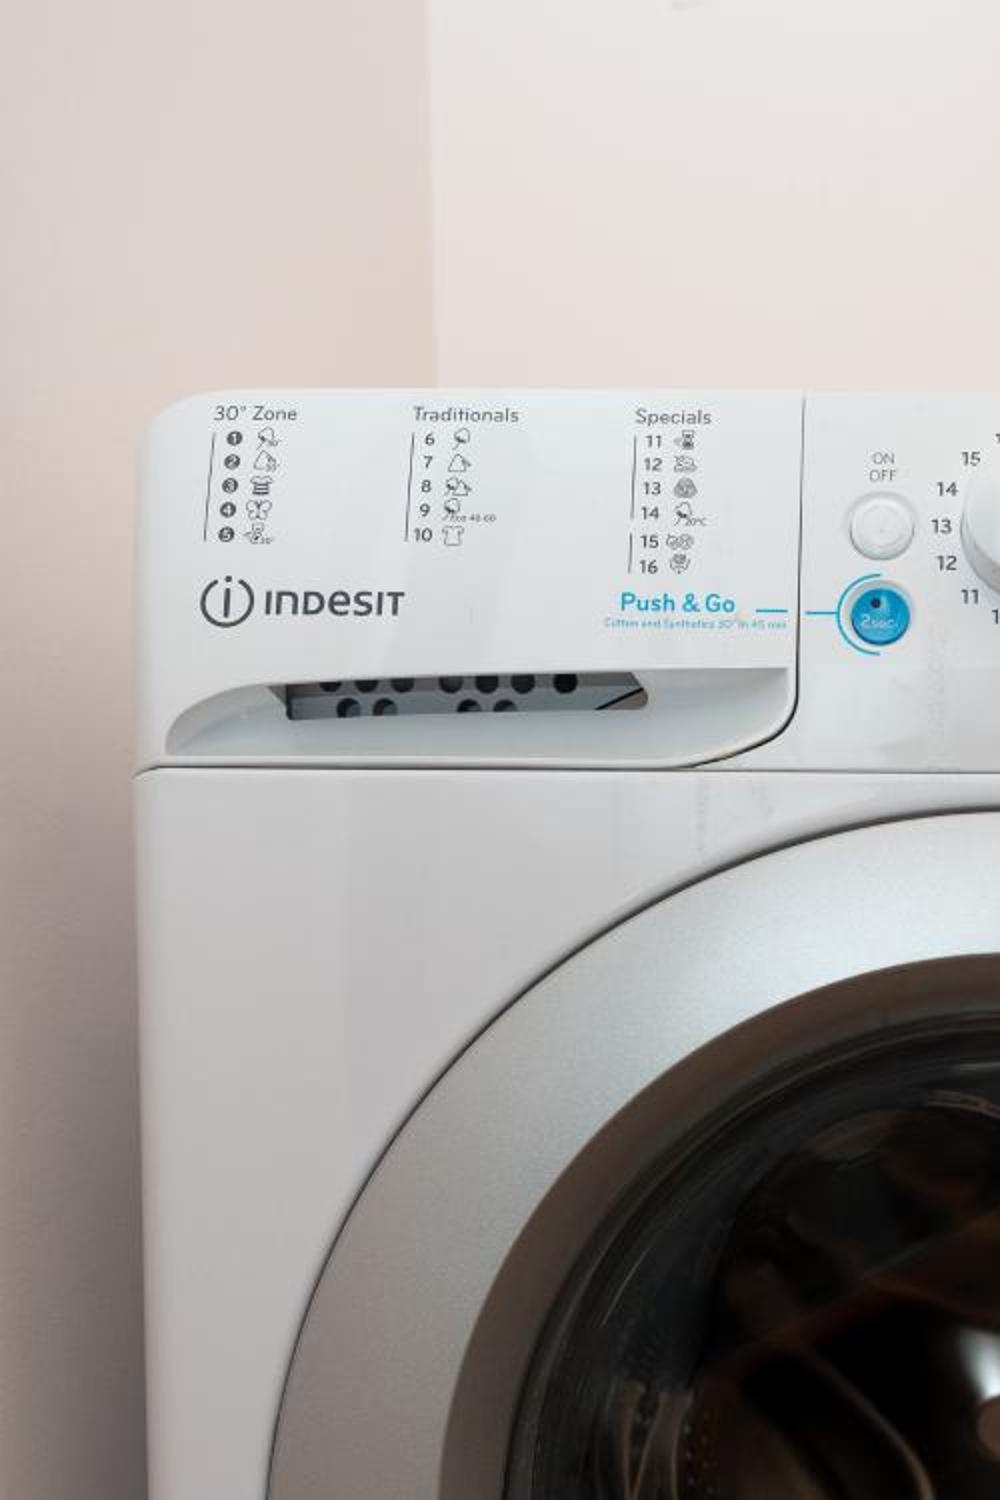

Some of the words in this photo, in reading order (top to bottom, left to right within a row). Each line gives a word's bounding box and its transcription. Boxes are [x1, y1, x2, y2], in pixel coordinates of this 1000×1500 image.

[252, 405, 297, 421] Zone
[413, 406, 519, 423] Traditionals
[635, 407, 712, 427] Specials
[424, 433, 435, 446] 6
[644, 435, 662, 448] 11
[423, 455, 433, 470] 7
[644, 457, 663, 471] 12
[872, 452, 896, 466] ON
[961, 451, 981, 466] 15
[868, 469, 897, 482] OFF
[421, 479, 432, 493] 8
[643, 481, 662, 496] 13
[936, 481, 959, 497] 14
[419, 503, 431, 518] 9
[641, 506, 660, 520] 14
[414, 527, 433, 542] 10
[931, 519, 953, 535] 13
[640, 534, 659, 549] 15
[639, 559, 659, 574] 16
[937, 555, 958, 571] 12
[620, 591, 675, 612] Push
[682, 593, 700, 613] &
[705, 592, 736, 613] Go
[960, 589, 980, 604] 11
